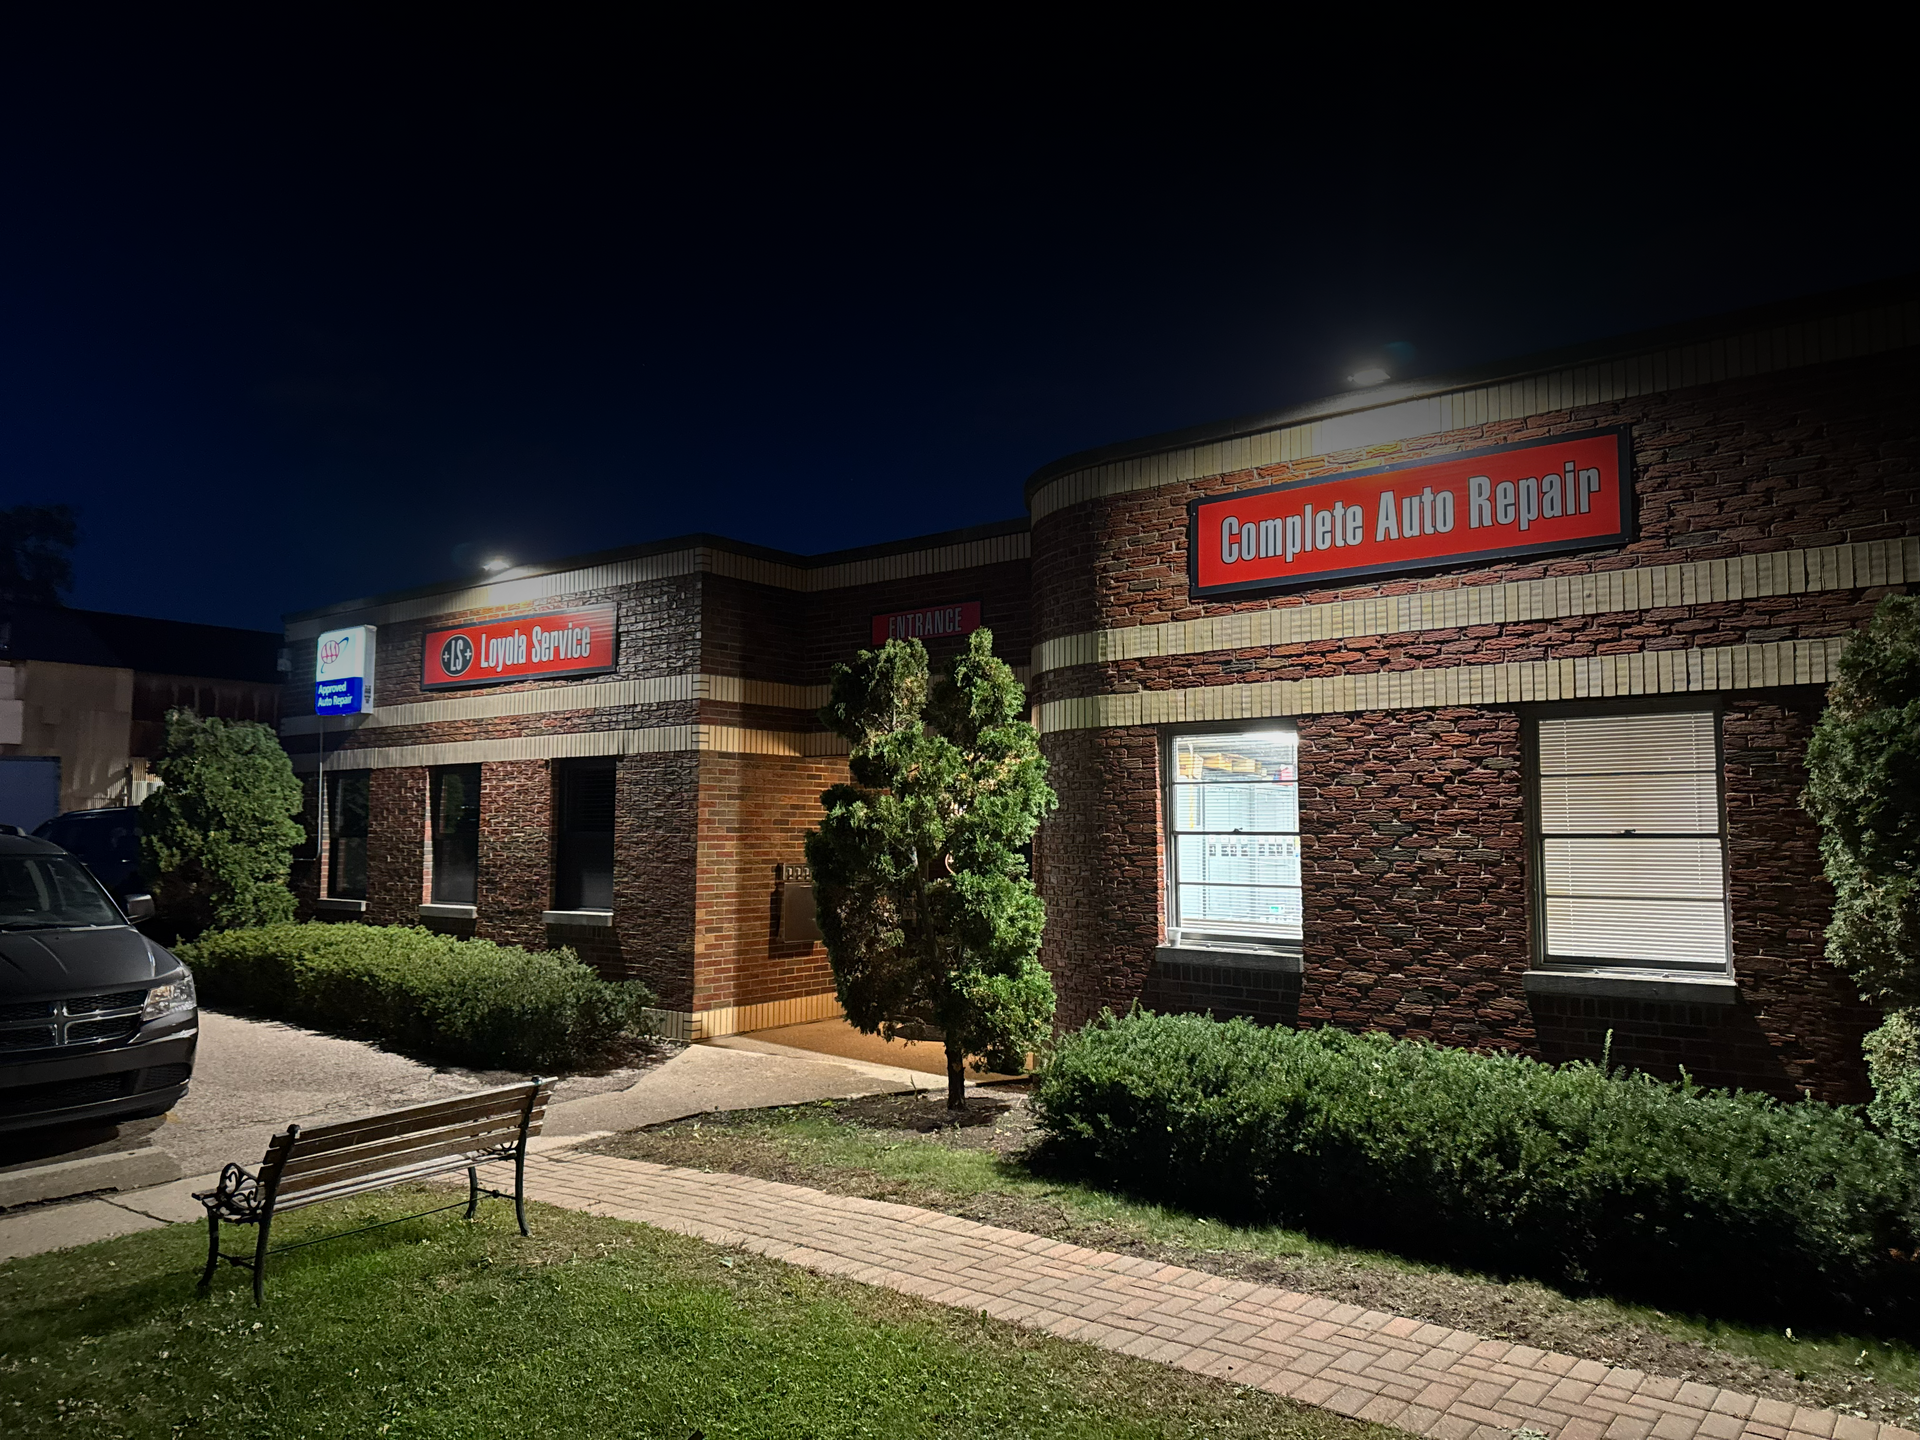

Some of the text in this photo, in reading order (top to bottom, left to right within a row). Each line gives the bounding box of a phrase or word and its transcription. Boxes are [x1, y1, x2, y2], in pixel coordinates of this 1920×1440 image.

[1220, 460, 1601, 564] Complete Auto Repair
[889, 607, 962, 639] ENTRANCE
[480, 622, 591, 673] Loyola Service
[317, 696, 333, 707] Auto
[333, 693, 353, 708] Repair
[318, 681, 347, 696] Approved
